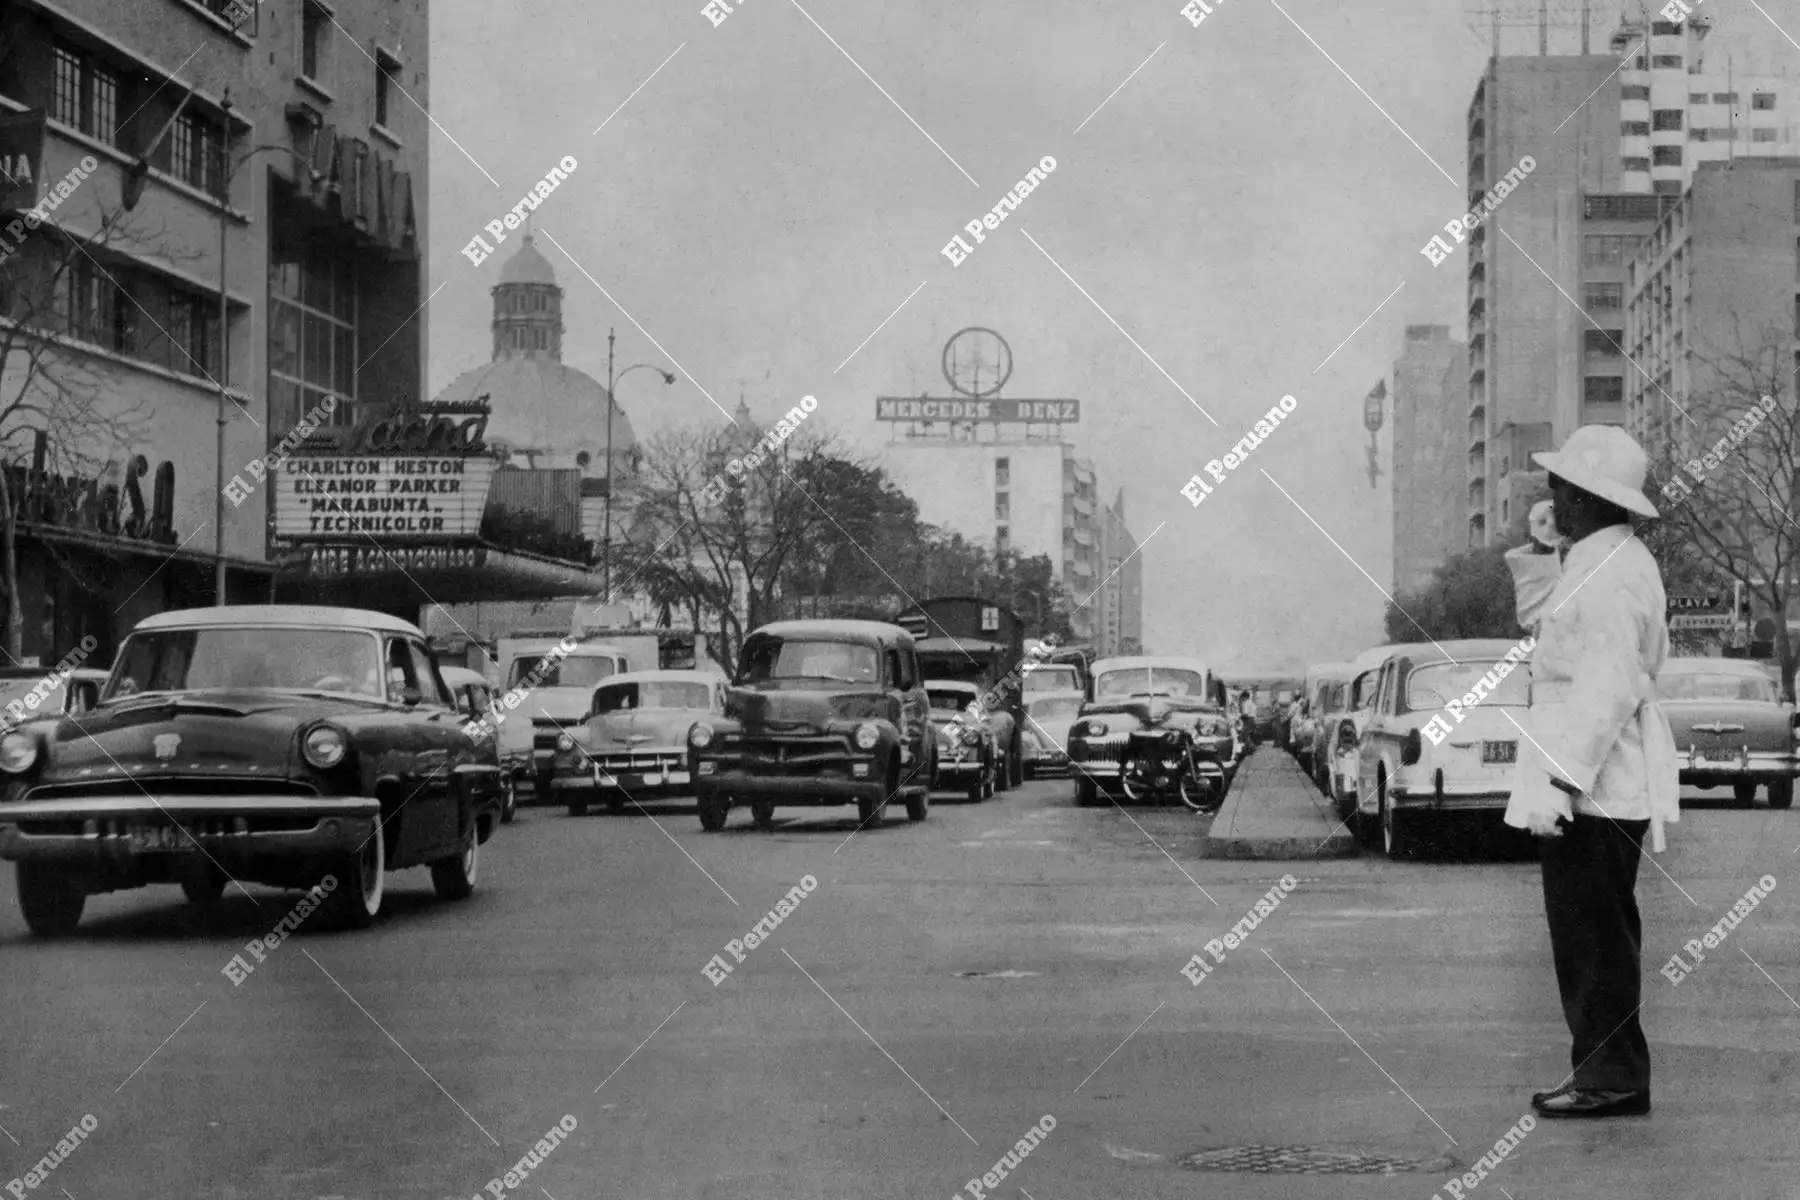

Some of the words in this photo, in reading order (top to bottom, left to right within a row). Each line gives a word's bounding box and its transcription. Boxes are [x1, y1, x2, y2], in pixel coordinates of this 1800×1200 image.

[879, 400, 991, 417] MERCEDES
[1017, 402, 1075, 418] BENZ
[286, 460, 380, 474] CHARLTON
[395, 460, 464, 474] HESTON
[294, 479, 376, 493] ELEANOR
[389, 479, 460, 493] PARKER
[310, 517, 444, 531] TECHNICOLOR
[310, 548, 349, 576] AIRE
